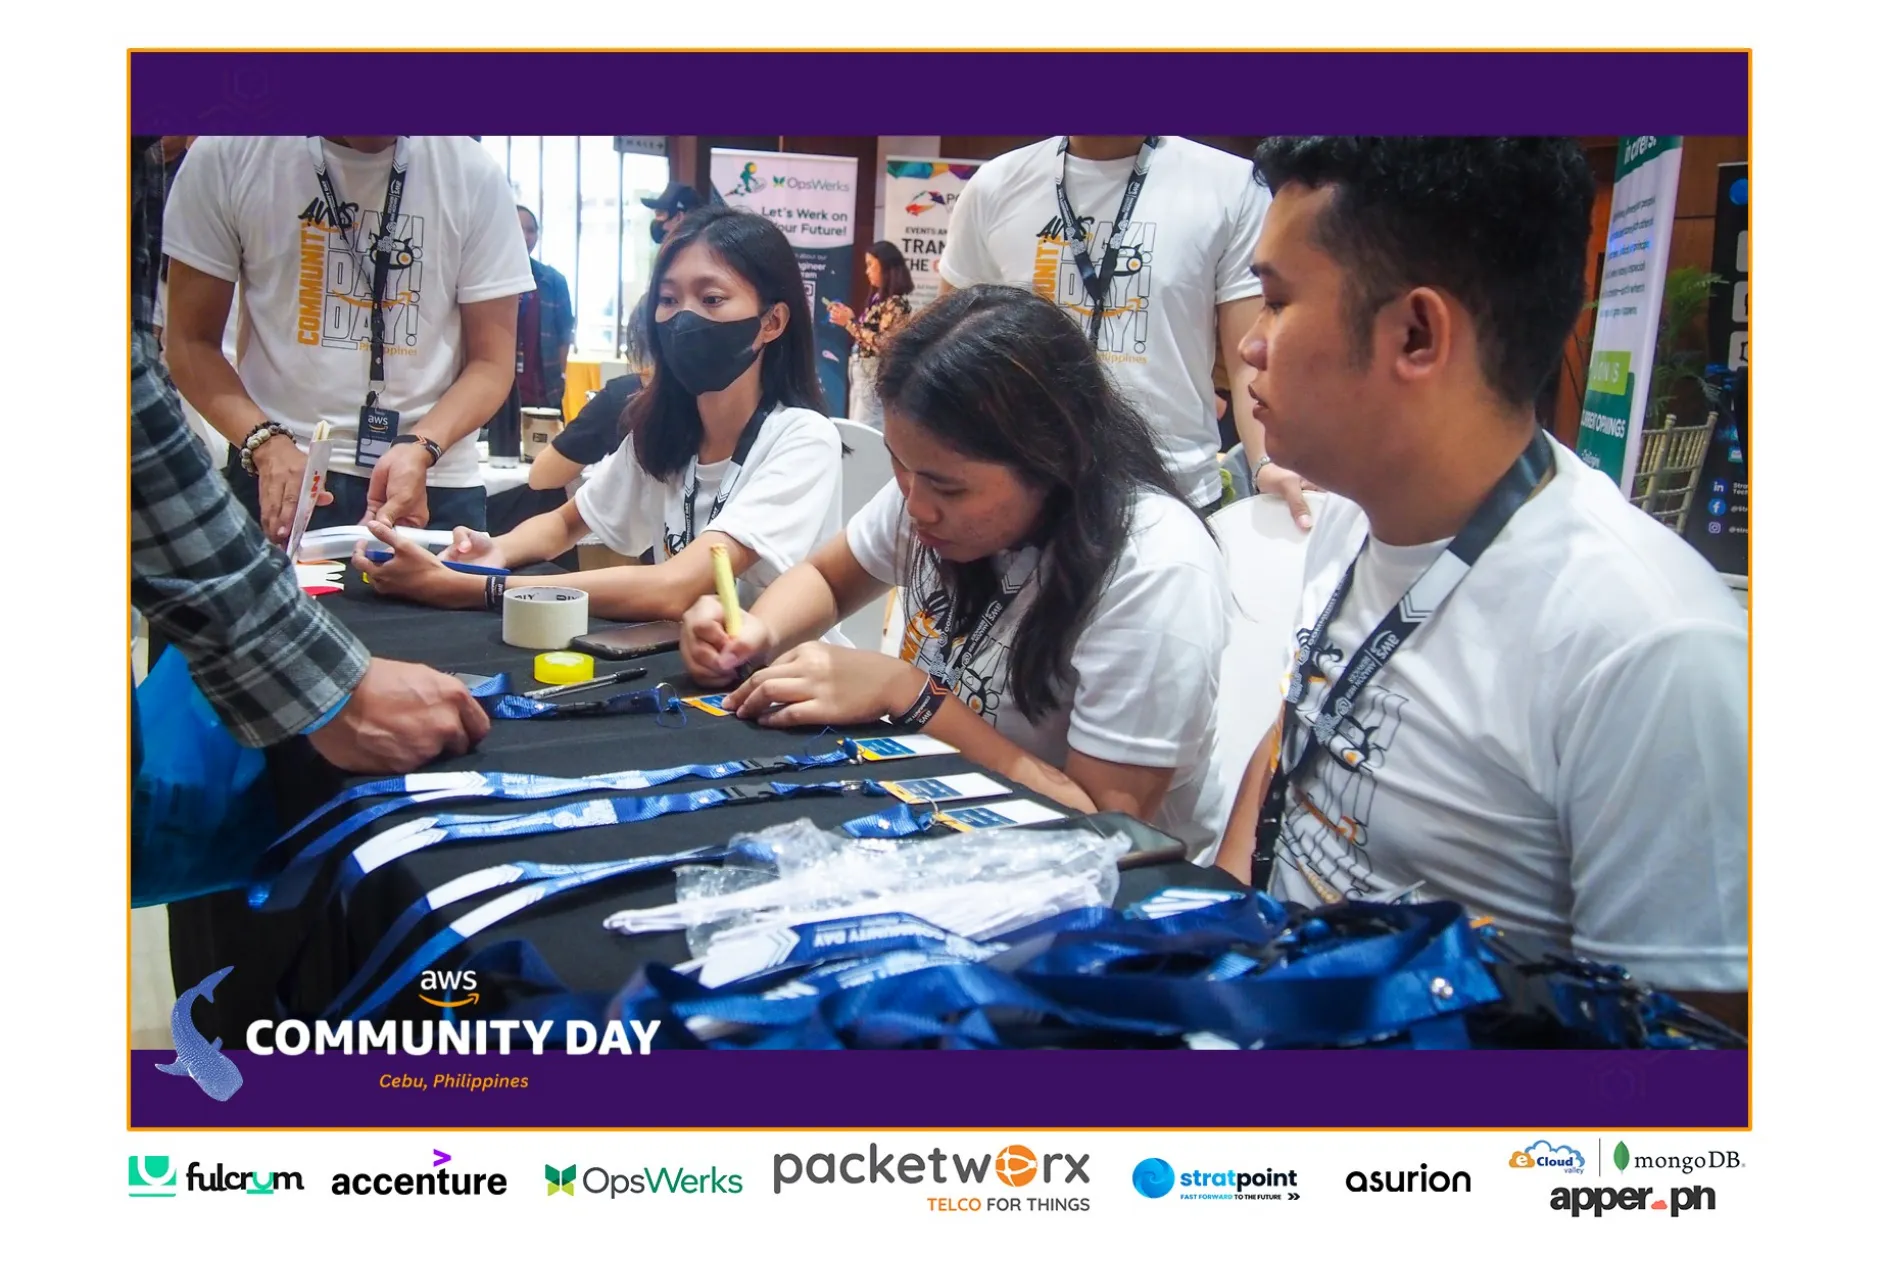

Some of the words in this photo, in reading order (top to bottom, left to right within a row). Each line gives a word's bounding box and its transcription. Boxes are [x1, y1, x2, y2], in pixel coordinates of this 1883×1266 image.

[787, 177, 850, 192] OpsWerks
[761, 206, 793, 218] Let's
[797, 208, 828, 220] Werk
[831, 212, 848, 222] on
[775, 222, 797, 234] our
[801, 223, 848, 236] Future!
[905, 226, 936, 235] EVENTS
[1032, 236, 1061, 301] UNITY
[359, 341, 418, 357] Phppines
[368, 415, 388, 425] aws
[987, 601, 1003, 622] aws
[1374, 632, 1400, 661] aws
[1347, 655, 1372, 684] SERVICES
[1354, 660, 1378, 688] AMAZON
[1344, 684, 1358, 699] WEB
[918, 709, 932, 725] aws
